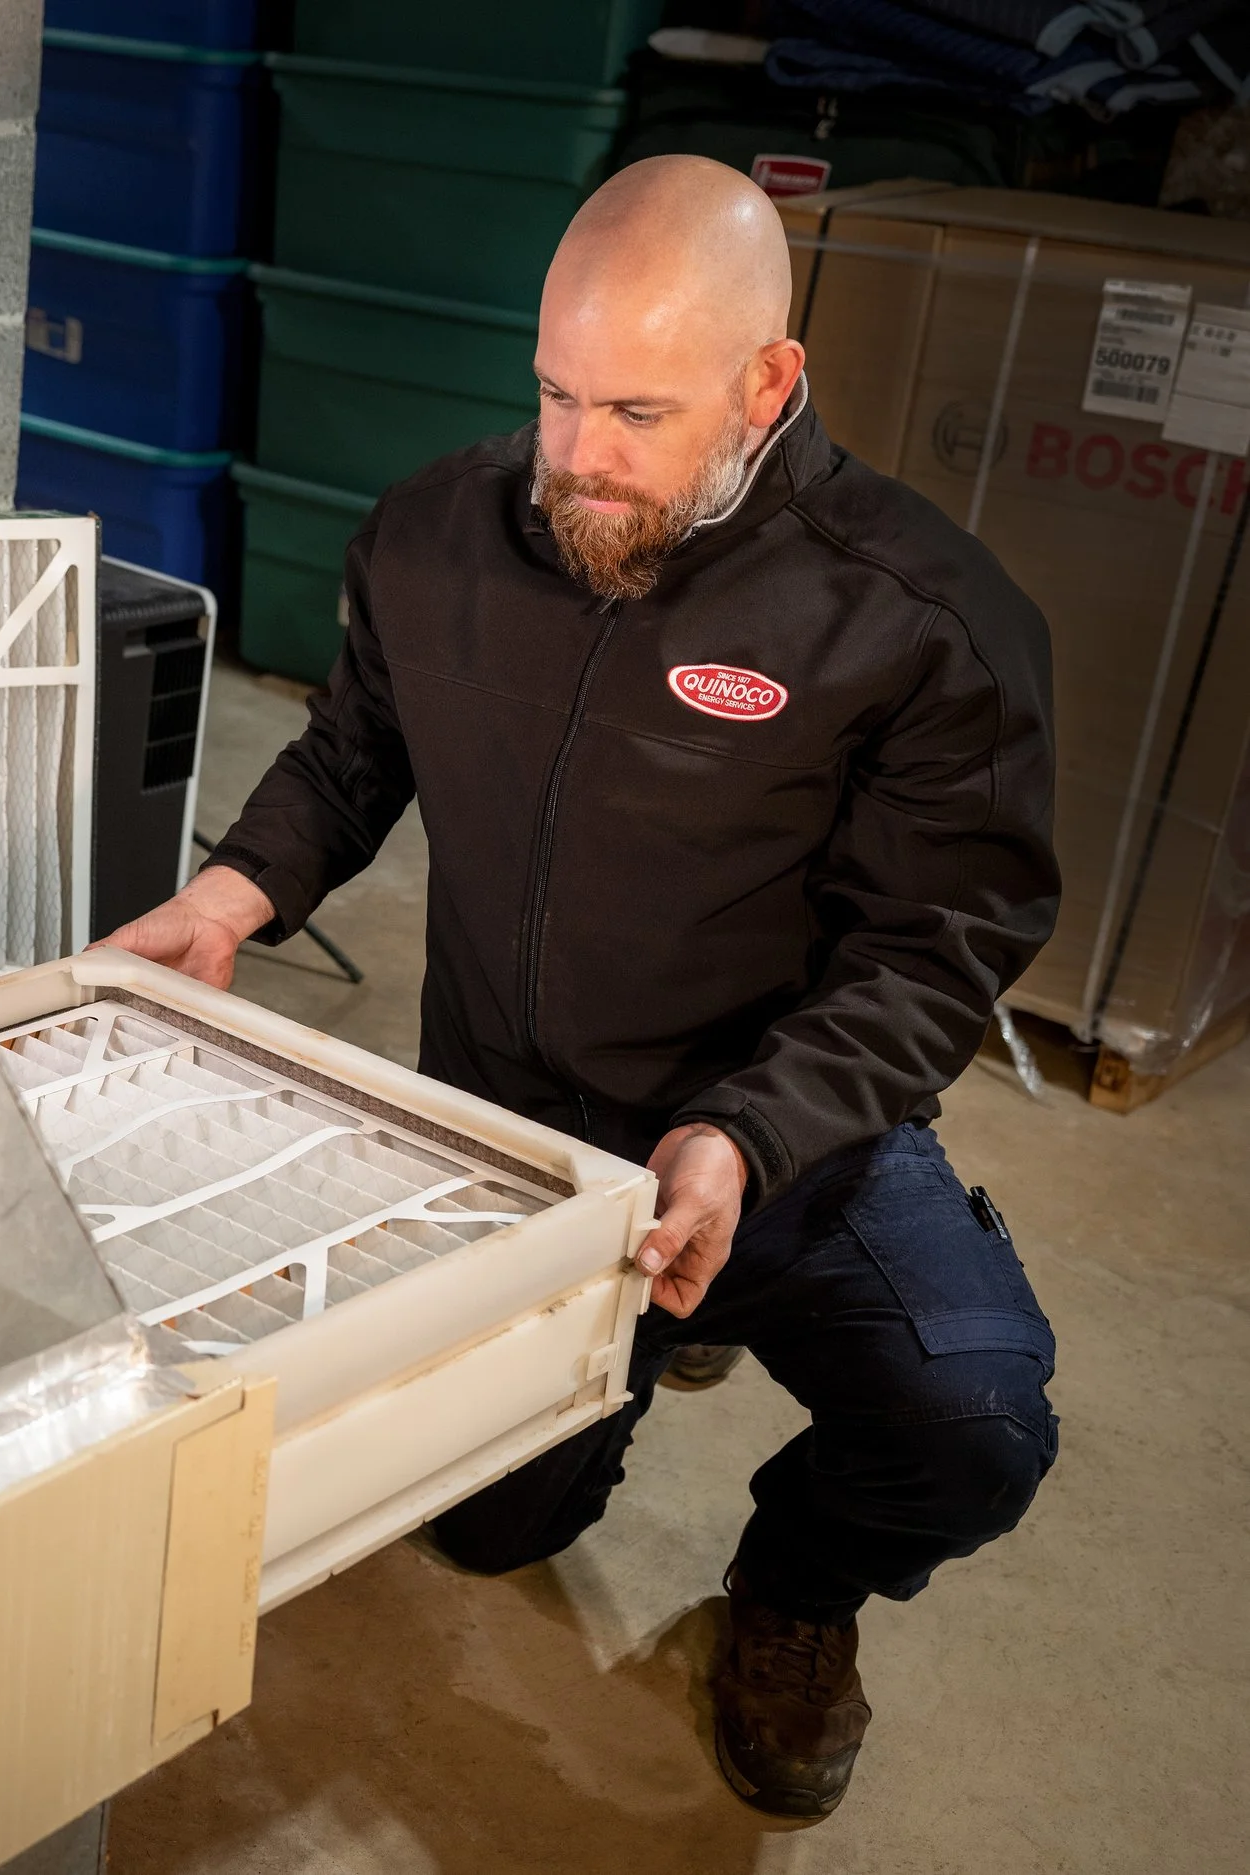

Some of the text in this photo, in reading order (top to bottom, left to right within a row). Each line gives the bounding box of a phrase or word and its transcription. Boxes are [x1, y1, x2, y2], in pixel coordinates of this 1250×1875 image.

[1095, 350, 1171, 375] 500079
[717, 672, 737, 681] SINCE
[683, 674, 774, 705] QUINOCO
[698, 694, 756, 711] ENERGY SERVICES
